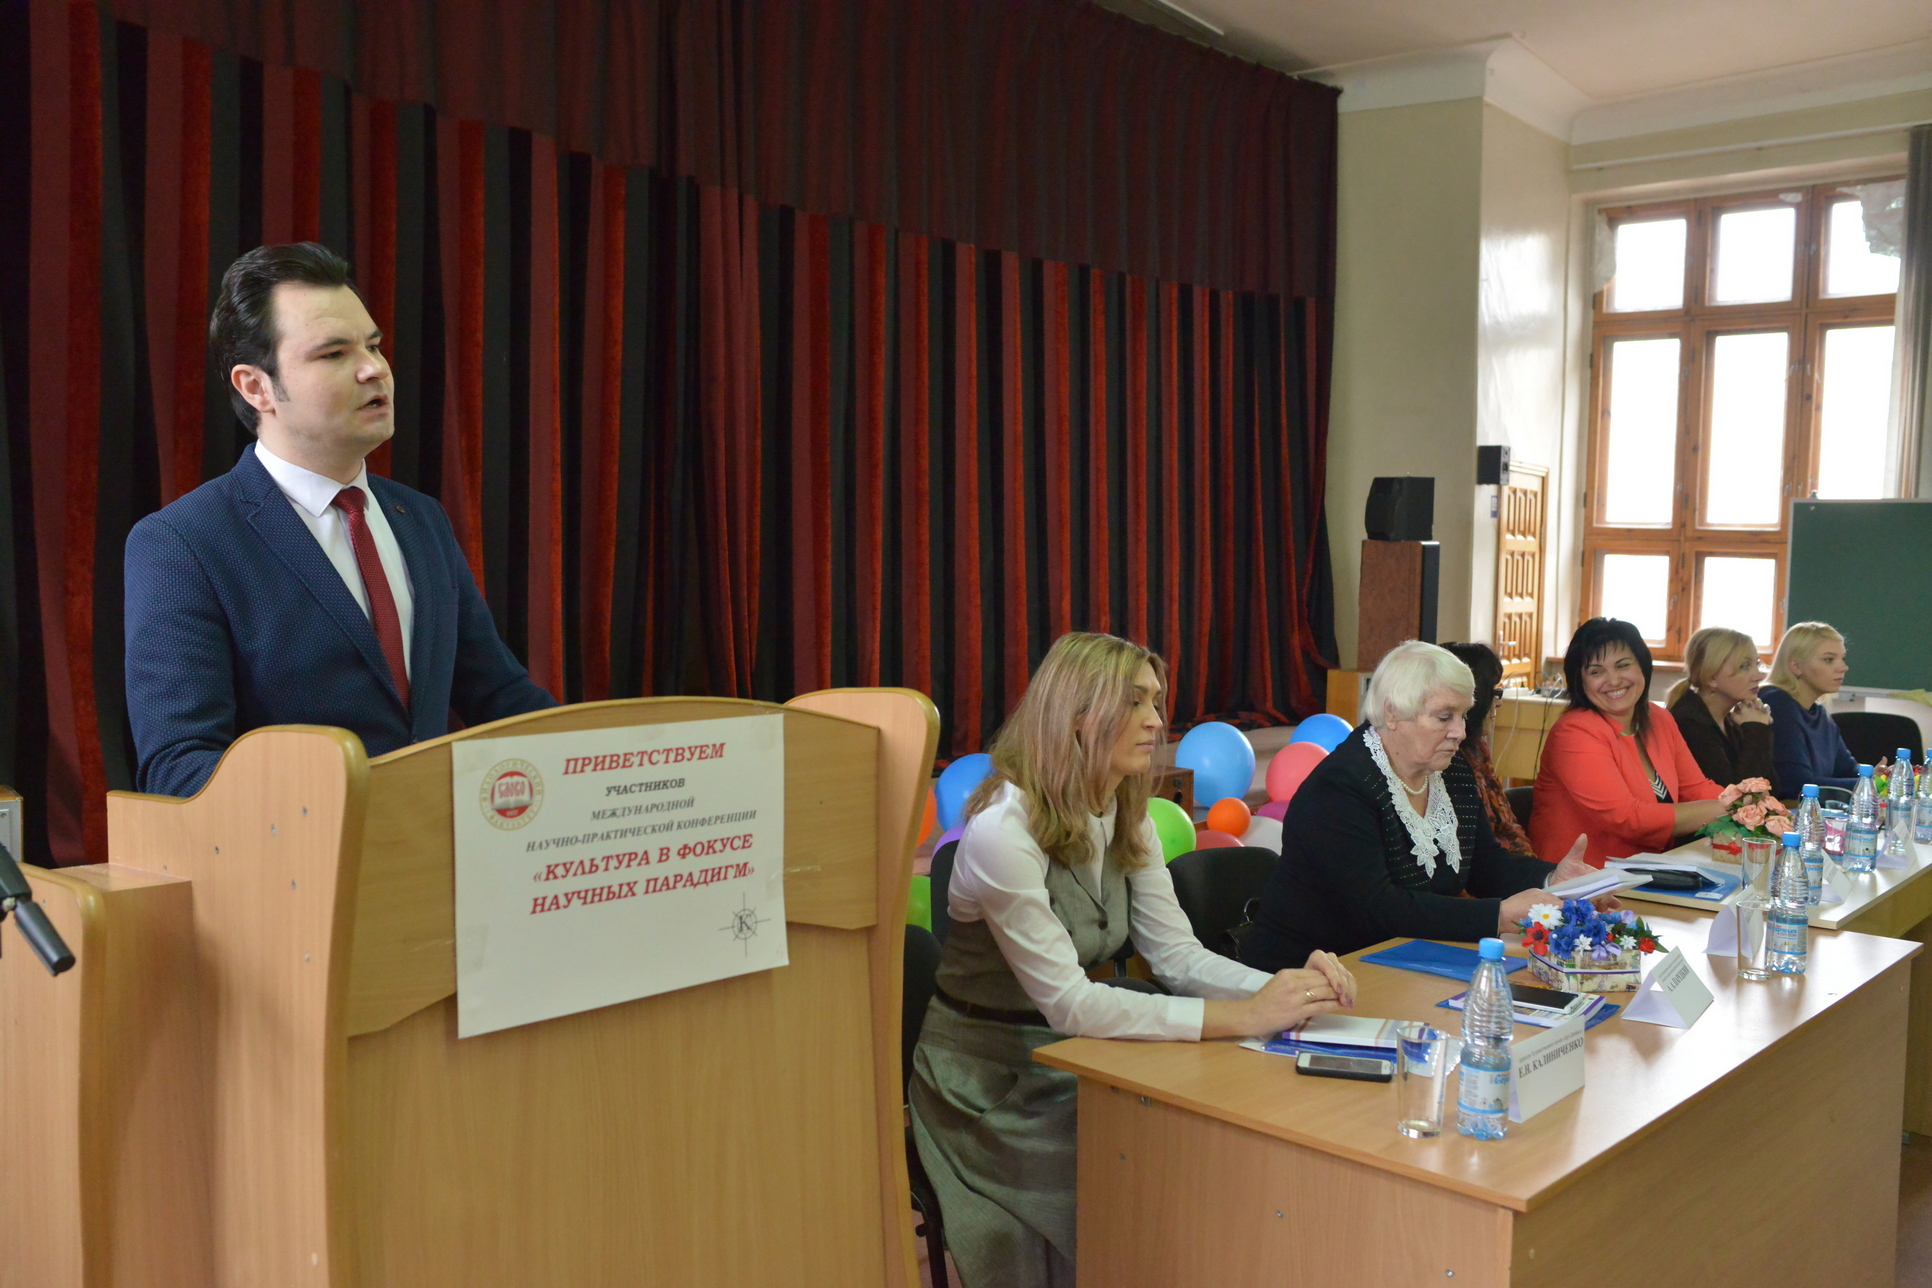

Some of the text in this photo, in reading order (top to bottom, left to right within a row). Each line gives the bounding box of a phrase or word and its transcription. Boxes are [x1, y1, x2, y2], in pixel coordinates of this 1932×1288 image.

[563, 743, 726, 775] ПРИВЕТСТВУЕМ
[605, 778, 685, 797] УЧАСТНИКОВ
[591, 796, 695, 821] МЕЖДУНАРОДНОЙ
[526, 810, 757, 853] НАУЧНО-ПРАКТИЧЕСКОЙ КОНФЕРЕНЦИИ
[533, 834, 753, 883] «КУЛЬТУРА В ФОКУСЕ
[530, 862, 754, 915] НАУЧНЫХ ПАРАДИГМ»
[1532, 1037, 1584, 1071] КАЛИНИЧЕНКО
